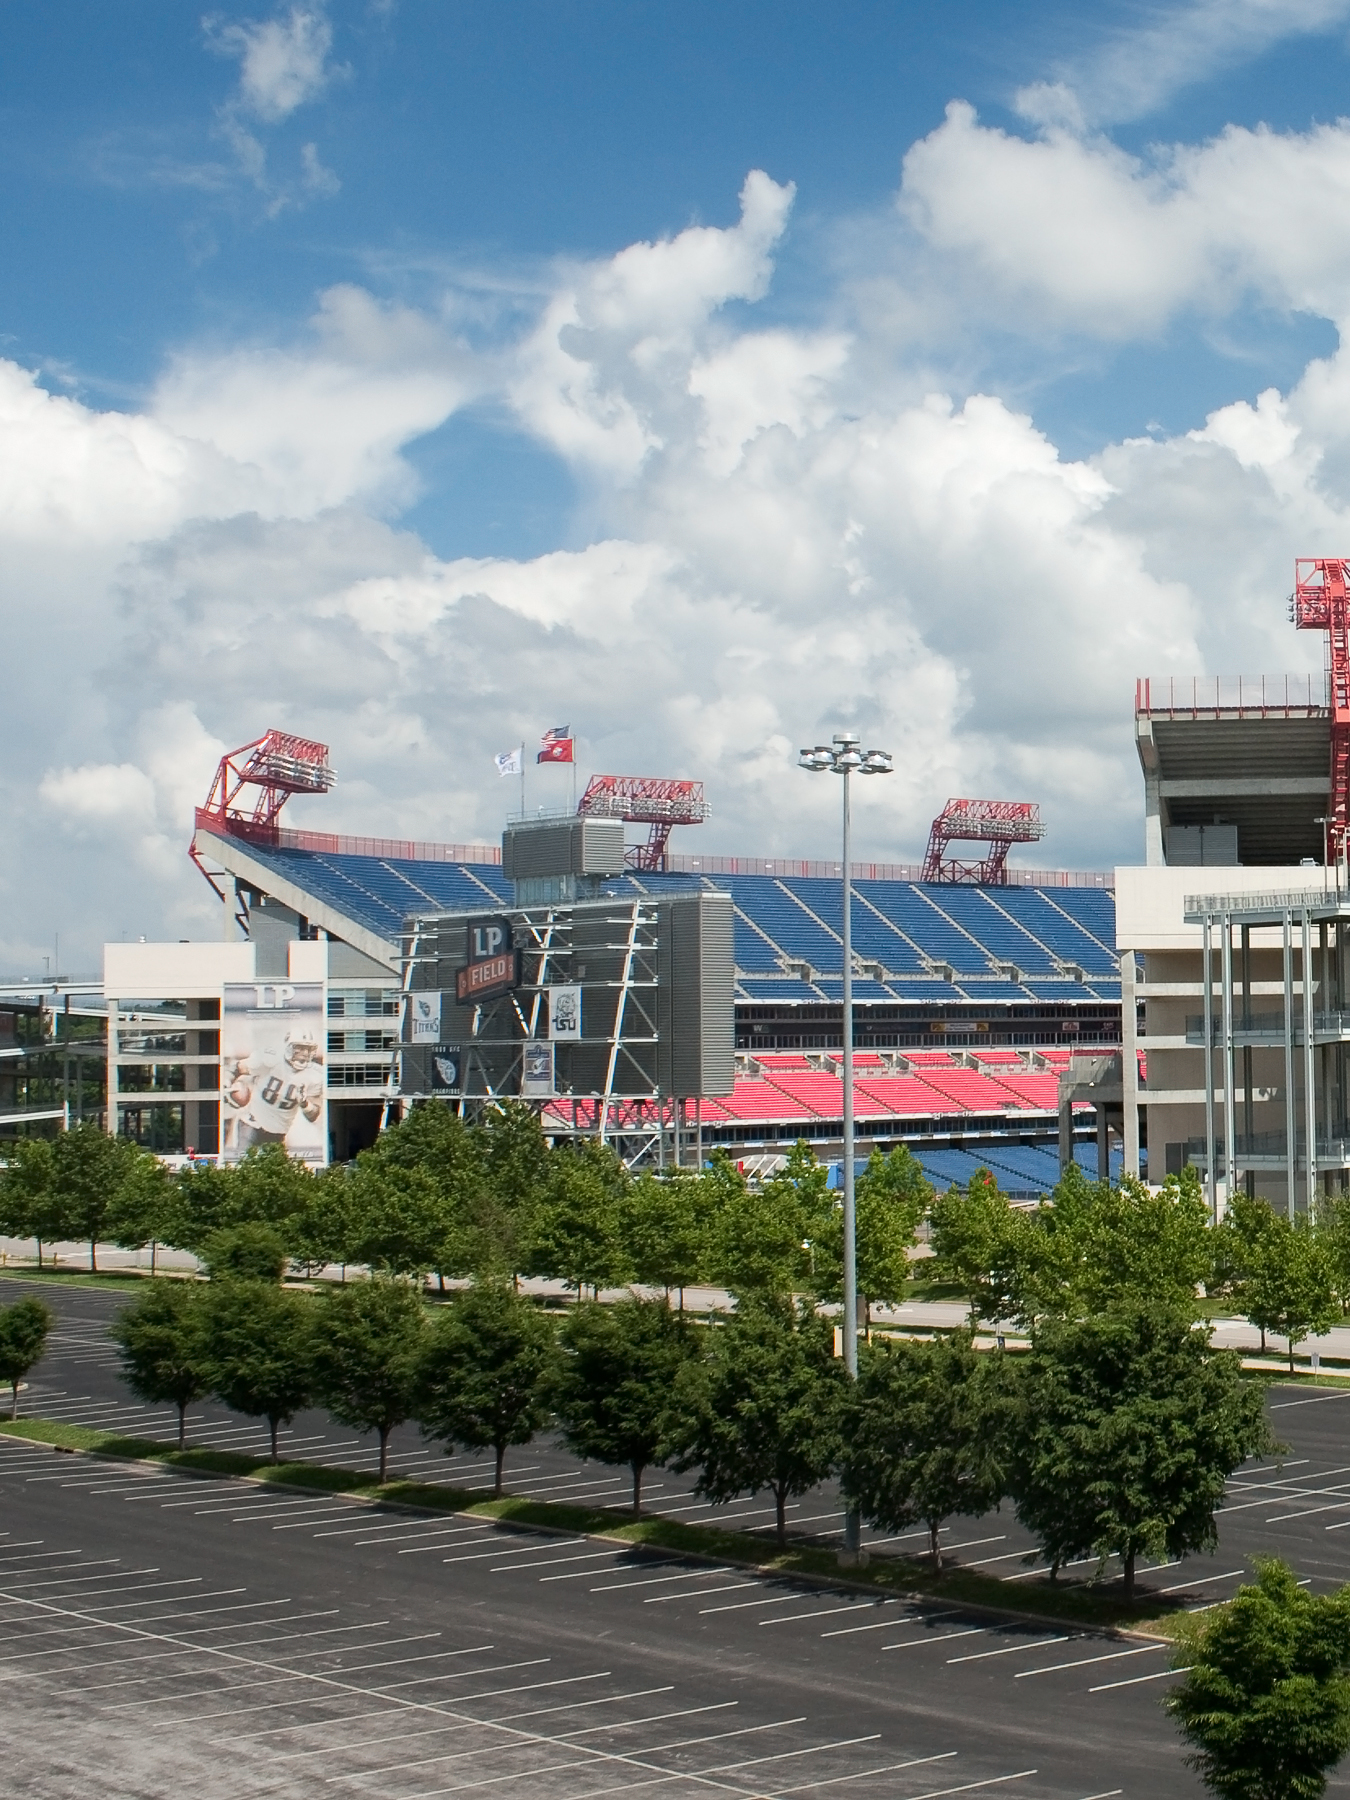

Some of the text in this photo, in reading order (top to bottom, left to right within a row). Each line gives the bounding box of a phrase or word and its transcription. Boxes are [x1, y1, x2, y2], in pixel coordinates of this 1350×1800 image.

[473, 926, 502, 956] LP
[471, 959, 506, 986] FIELD
[253, 985, 296, 1009] LP
